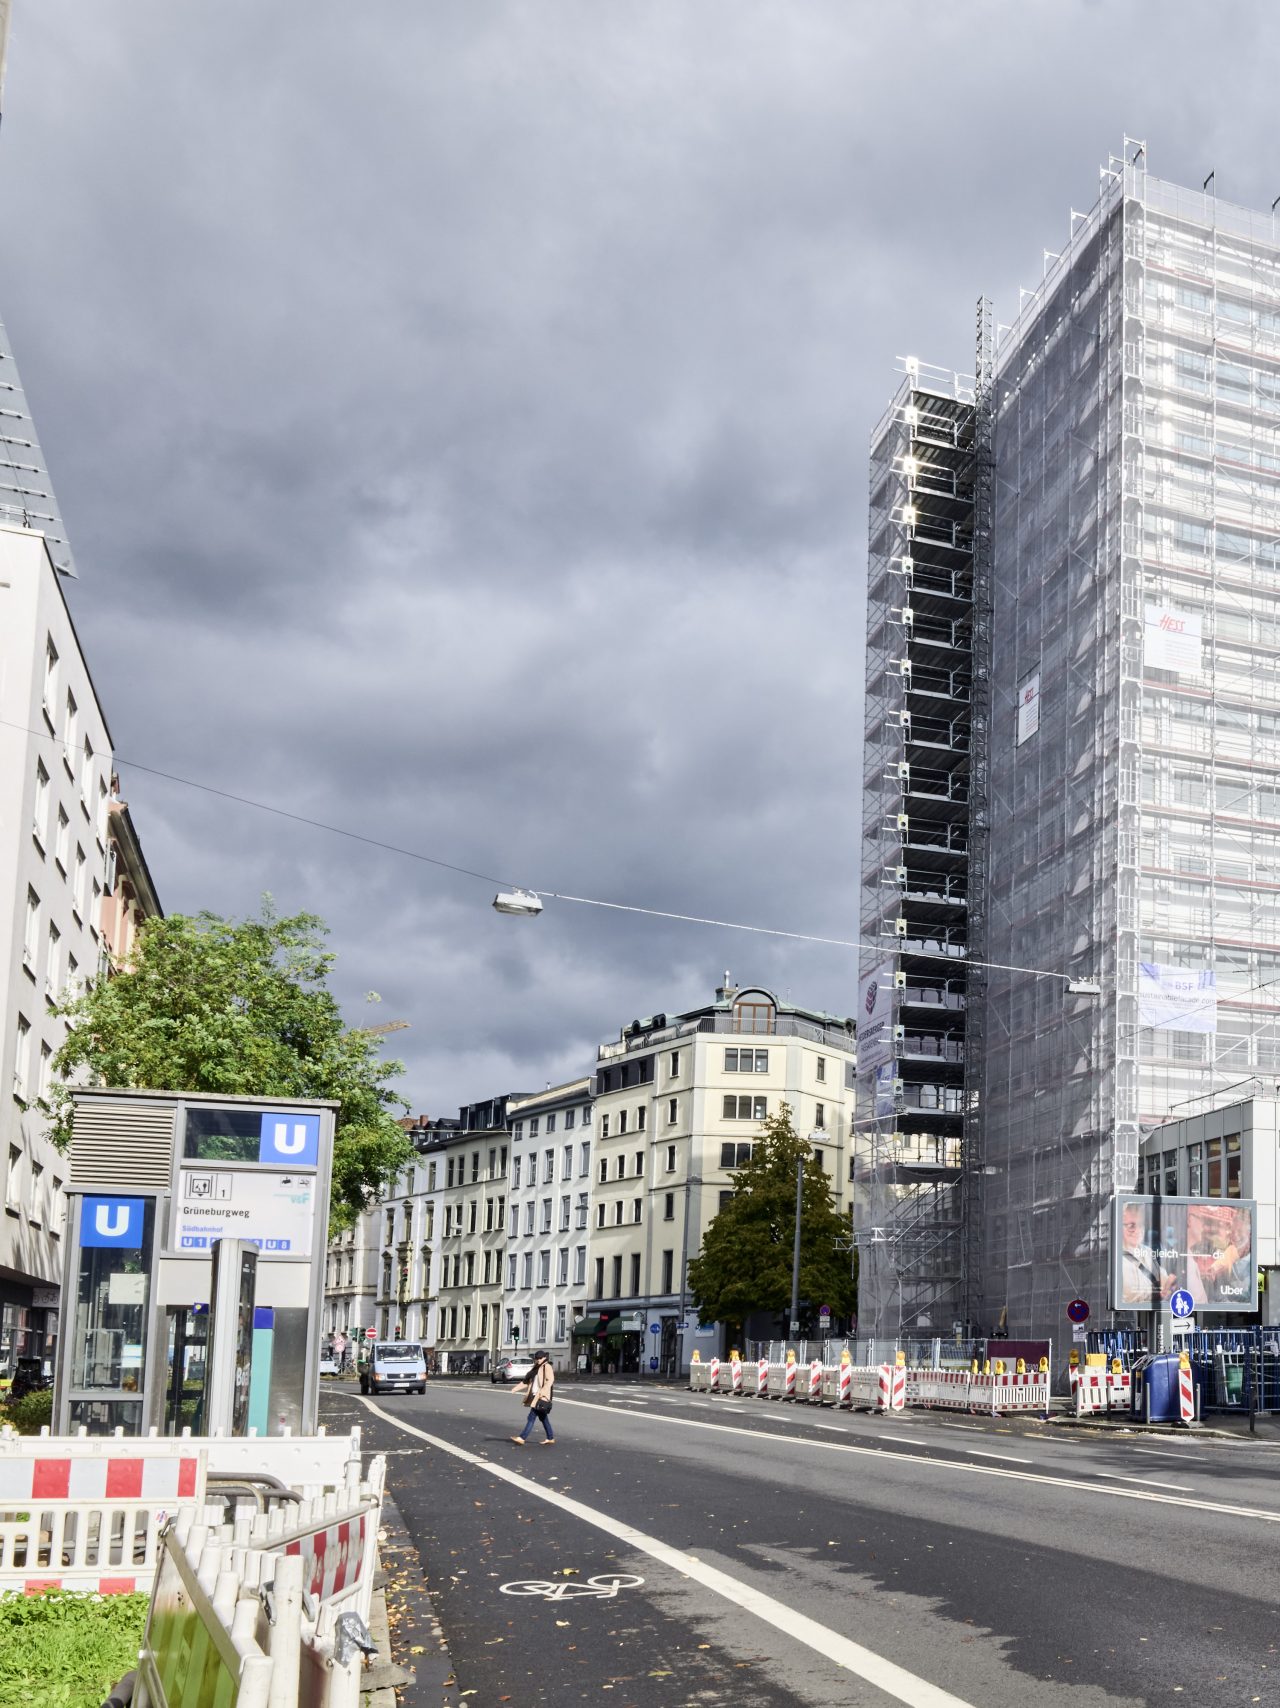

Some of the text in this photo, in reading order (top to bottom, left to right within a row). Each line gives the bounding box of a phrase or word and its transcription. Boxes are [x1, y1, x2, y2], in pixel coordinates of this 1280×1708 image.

[274, 1123, 307, 1154] U
[183, 1206, 250, 1218] Grüneburgweg
[95, 1205, 130, 1237] U
[182, 1225, 224, 1233] Südbahnhof
[1151, 1248, 1179, 1260] gleich
[1212, 1248, 1225, 1259] da
[1220, 1285, 1244, 1295] Uber
